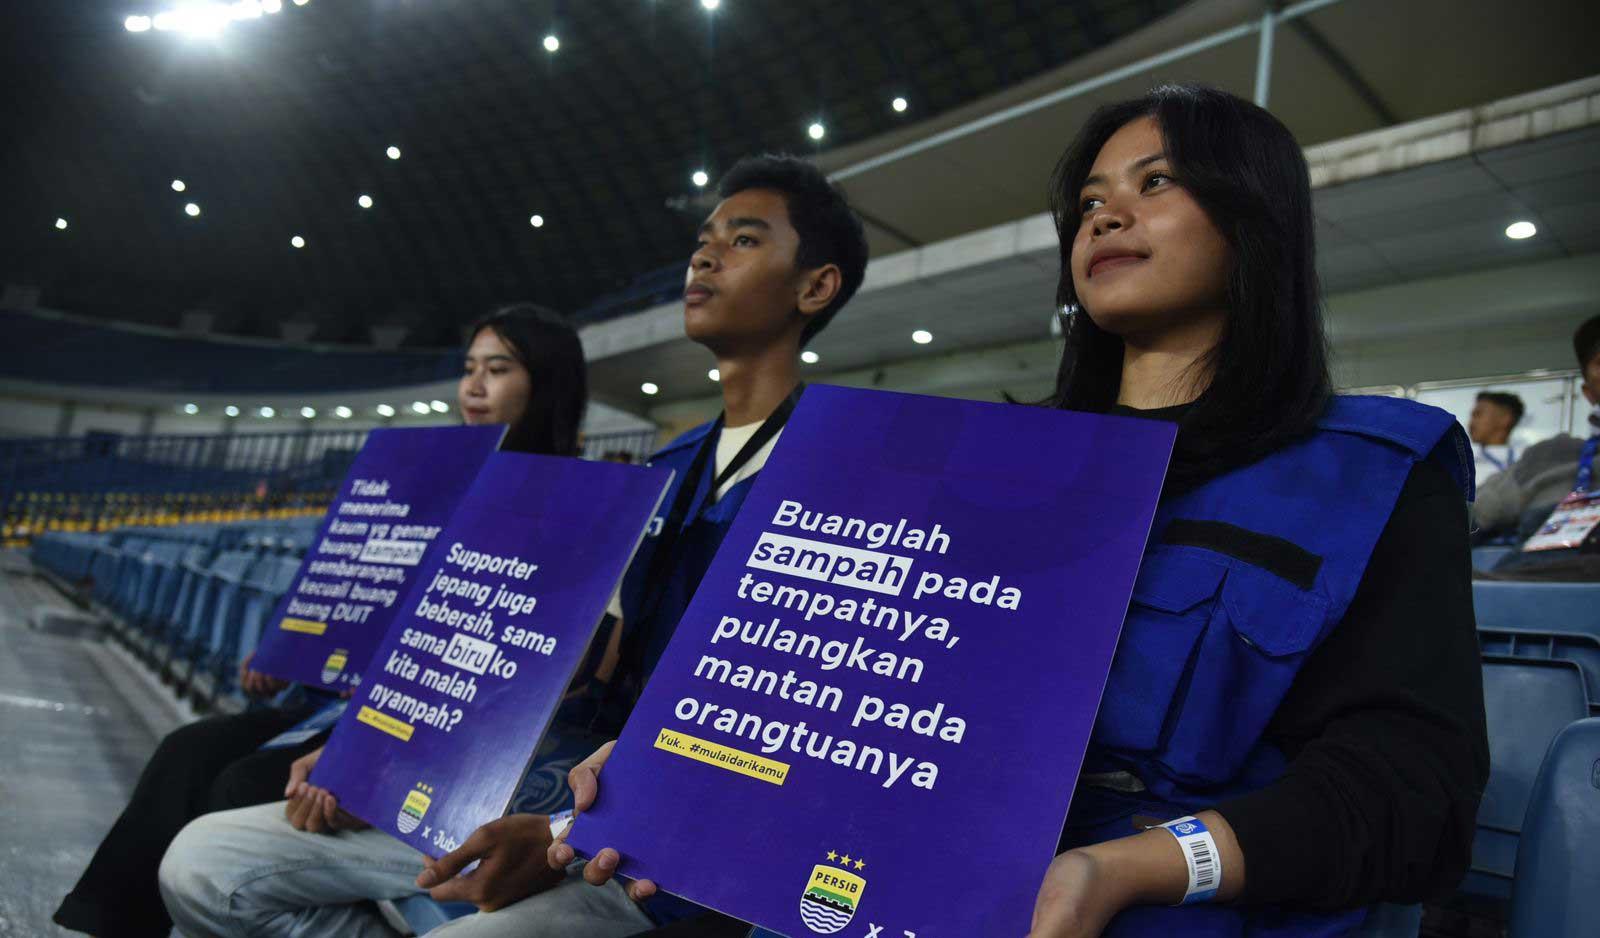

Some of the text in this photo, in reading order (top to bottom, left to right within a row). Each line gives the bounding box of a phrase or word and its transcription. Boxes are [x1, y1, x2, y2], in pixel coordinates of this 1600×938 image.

[338, 500, 410, 517] menerima
[350, 479, 390, 496] Tidak
[318, 538, 364, 560] buang
[328, 518, 441, 540] kaum yg gemar
[772, 500, 950, 554] Buanglah
[446, 542, 538, 580] Supporter
[753, 537, 1022, 610] sampah pada
[286, 598, 374, 624] buang DUIT
[297, 578, 398, 607] kecuali buang
[426, 568, 537, 616] jepang juga
[737, 573, 960, 649] tempatnya,
[415, 595, 557, 656] bebersih, sama
[711, 615, 924, 682] pulangkan
[384, 650, 420, 682] kita
[419, 667, 477, 703] malah
[400, 628, 517, 679] sama biru ko
[368, 683, 463, 732] nyampah?
[694, 654, 967, 744] mantan pada
[660, 733, 784, 779] Yuk.. #mulaidarikamu
[674, 697, 939, 789] orangtuanya
[433, 830, 461, 853] Jub
[815, 872, 859, 893] PERSIB
